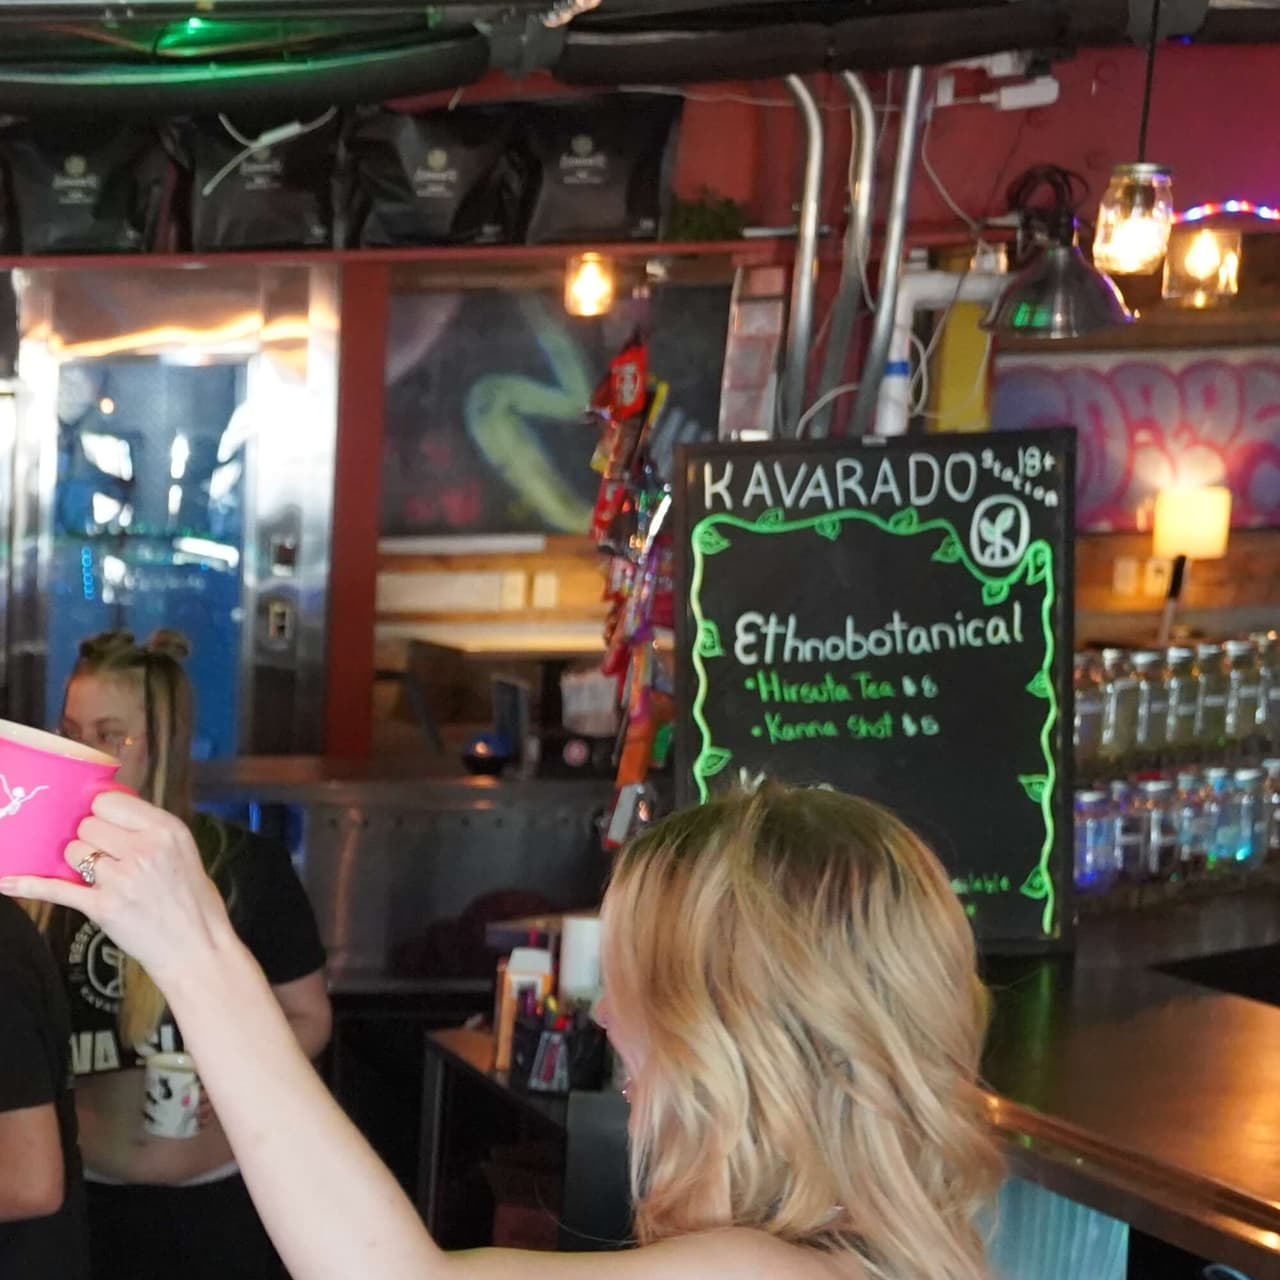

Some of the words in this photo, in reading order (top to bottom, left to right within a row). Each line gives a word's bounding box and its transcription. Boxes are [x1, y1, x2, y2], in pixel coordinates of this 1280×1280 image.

[703, 451, 978, 511] KAVARADO
[1018, 445, 1055, 487] 18+
[981, 448, 1058, 507] Station
[734, 600, 1025, 665] Ethnobotanical
[851, 671, 895, 699] Tea
[764, 712, 838, 744] Kanna
[847, 711, 894, 740] Shot
